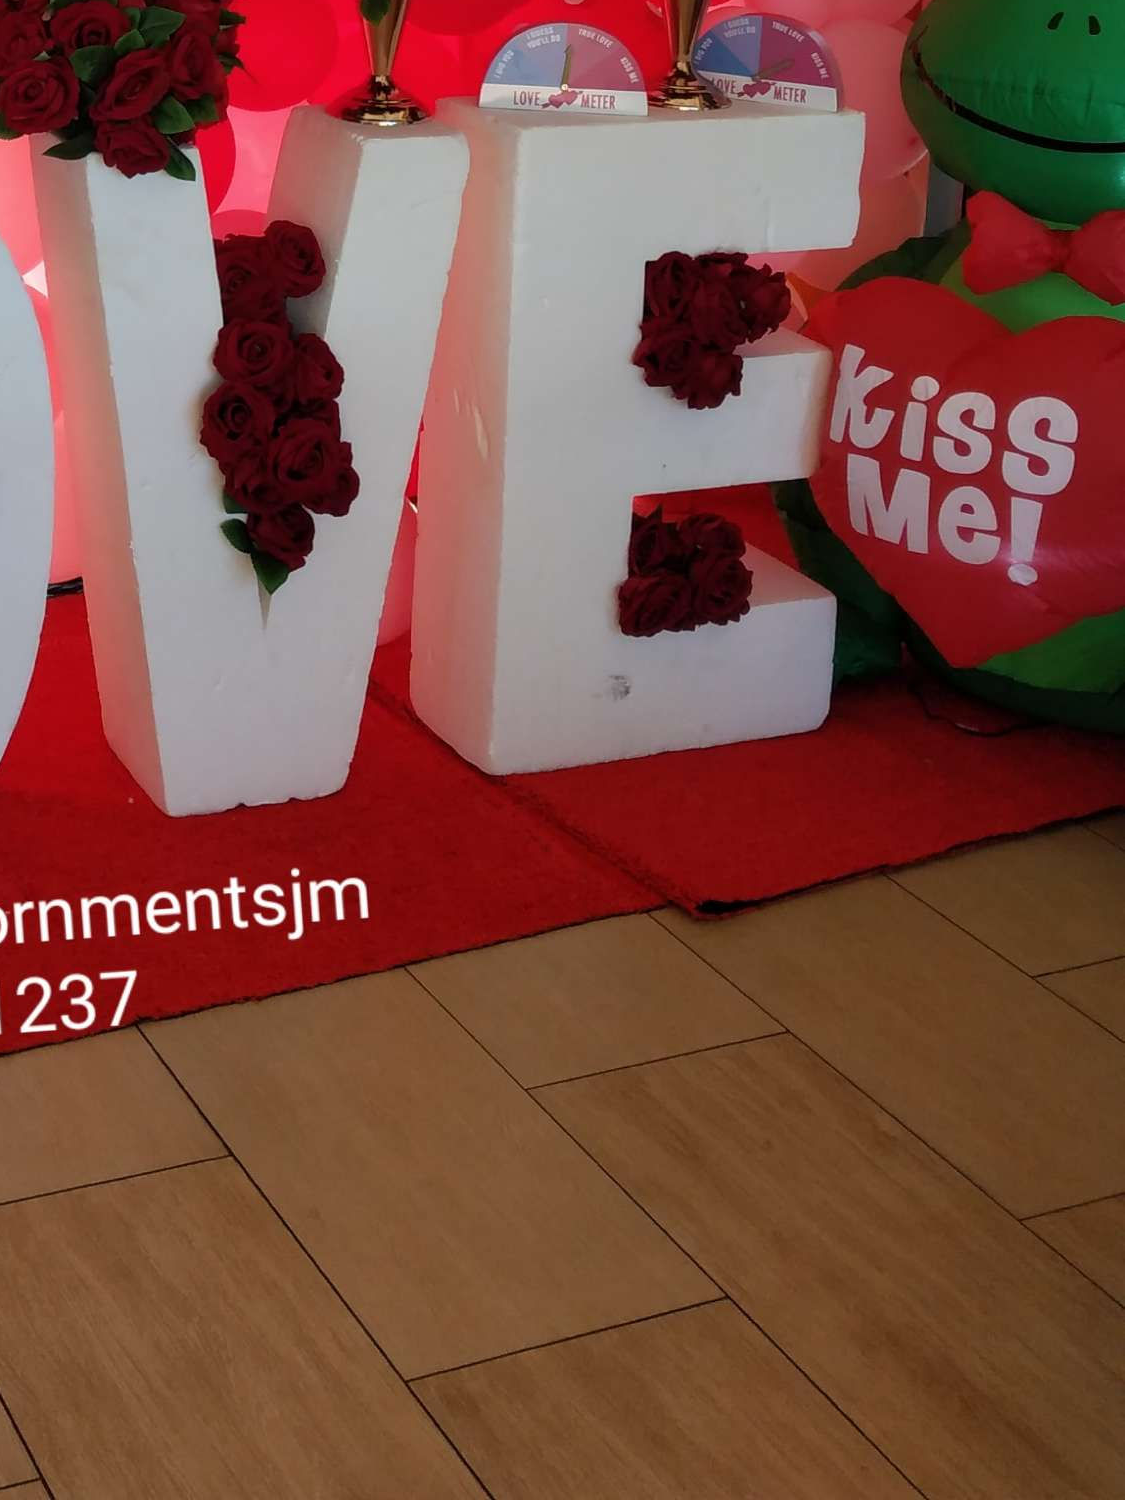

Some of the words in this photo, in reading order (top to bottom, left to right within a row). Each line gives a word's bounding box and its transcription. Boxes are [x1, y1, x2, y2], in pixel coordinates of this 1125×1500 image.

[578, 28, 596, 41] TRUE
[596, 34, 614, 49] LOVE
[772, 20, 789, 34] TRUE
[788, 29, 805, 43] LOVE
[620, 56, 634, 73] KISS
[628, 71, 640, 84] ME
[513, 90, 541, 106] LOVE
[580, 93, 616, 110] METER
[773, 86, 807, 104] METER
[829, 343, 1079, 495] Kiss
[846, 453, 1044, 586] Me!
